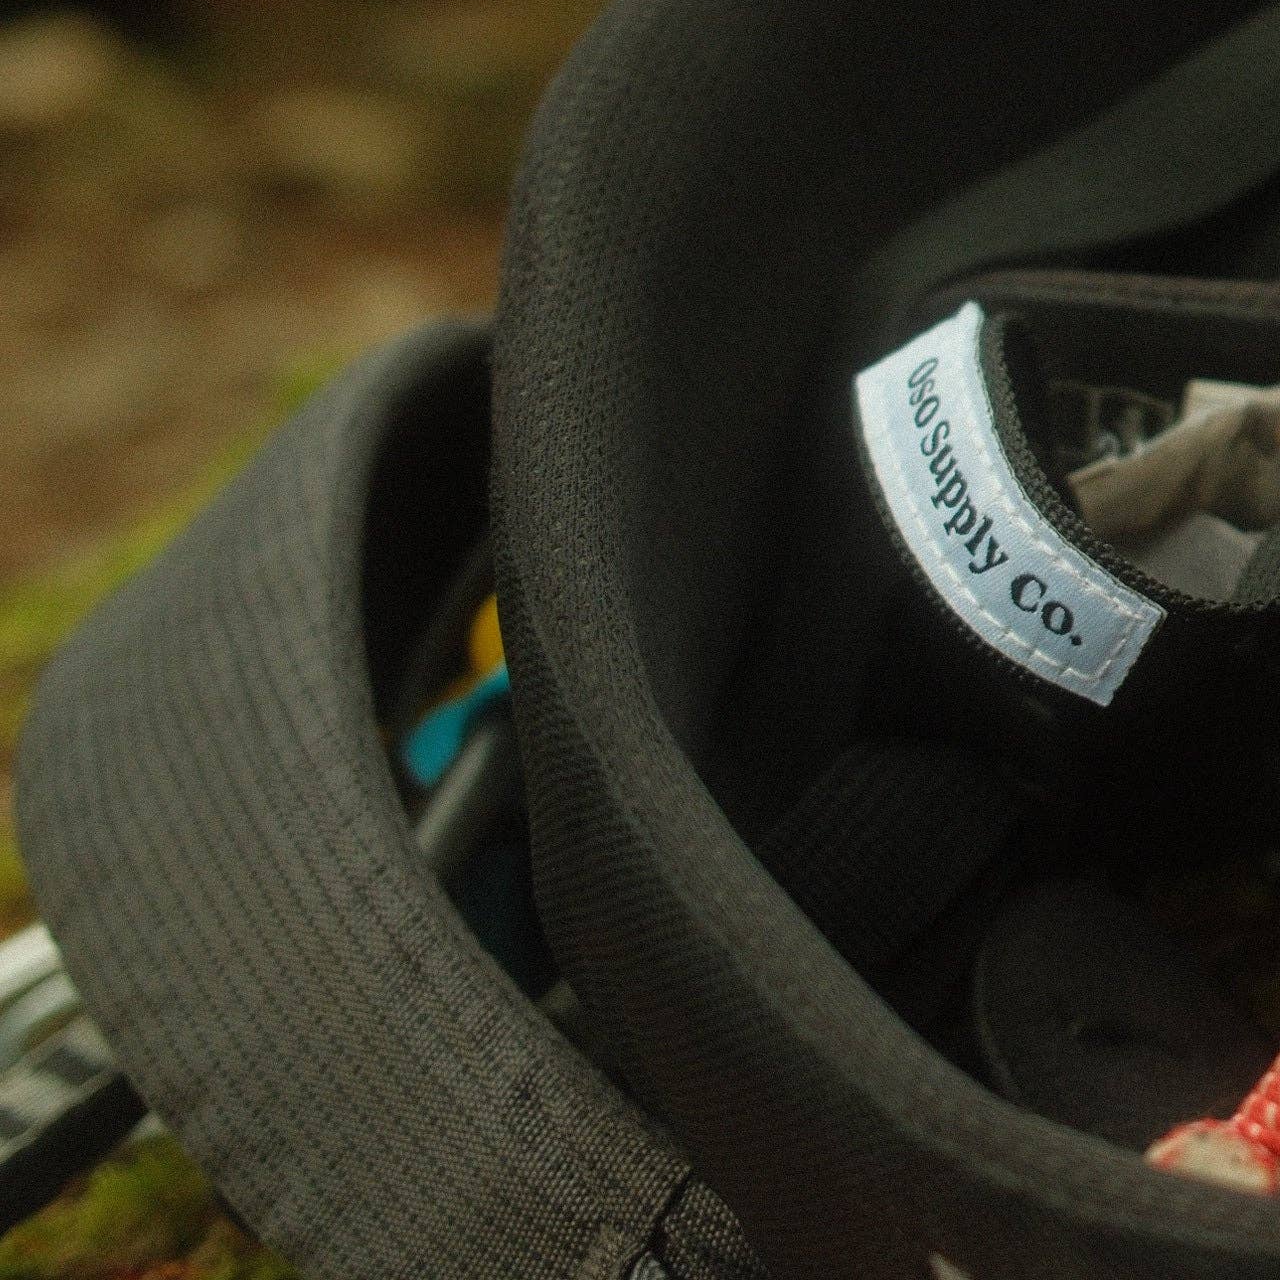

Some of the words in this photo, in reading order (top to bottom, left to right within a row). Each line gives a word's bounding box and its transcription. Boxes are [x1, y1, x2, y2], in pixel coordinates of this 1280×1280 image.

[907, 357, 942, 429] Oso
[920, 420, 1009, 575] Supply
[1010, 572, 1083, 647] Co.
